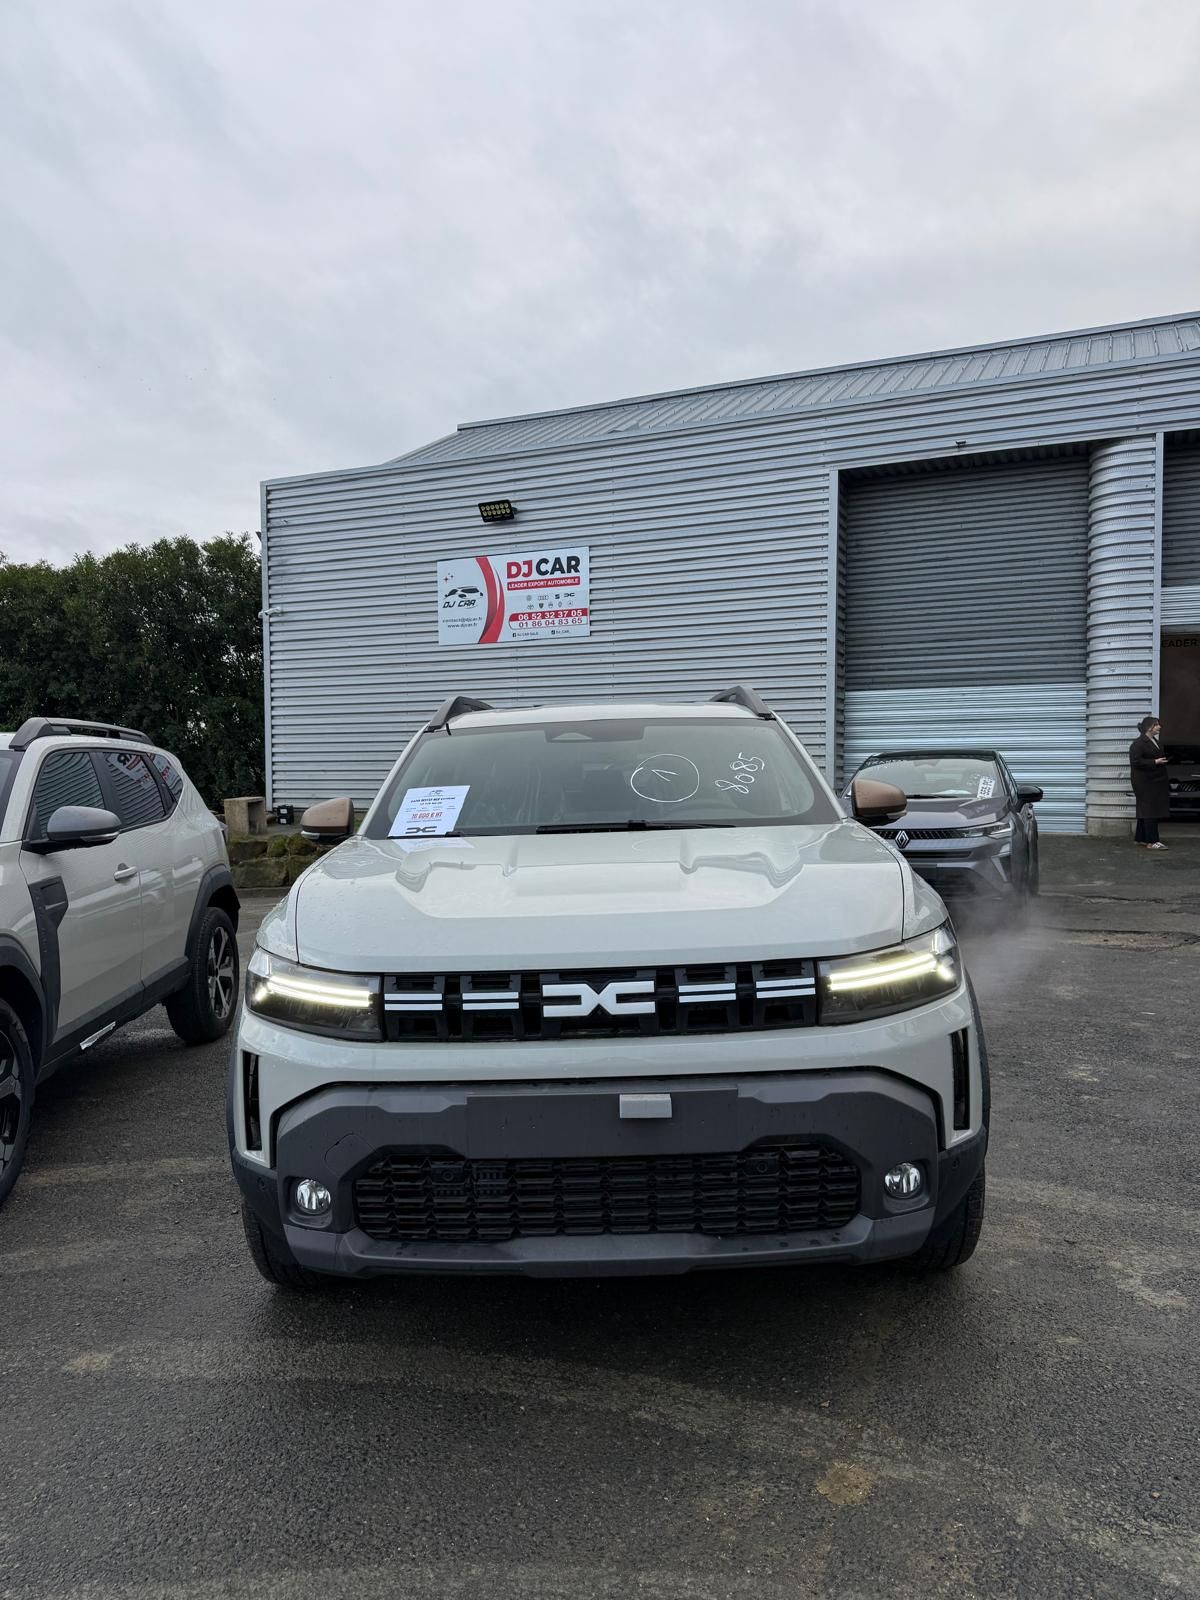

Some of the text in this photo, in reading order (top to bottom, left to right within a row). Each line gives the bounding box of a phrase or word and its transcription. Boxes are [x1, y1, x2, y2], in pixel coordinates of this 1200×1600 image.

[506, 556, 581, 579] DJ CAR
[528, 580, 547, 588] EXPORT
[547, 578, 579, 587] AUTOMOBILE
[442, 599, 477, 608] DJ CAR
[518, 609, 582, 621] 06 52 32 37 05
[531, 620, 542, 628] 86
[544, 619, 555, 627] 04
[558, 618, 569, 626] 83
[571, 617, 582, 625] 65
